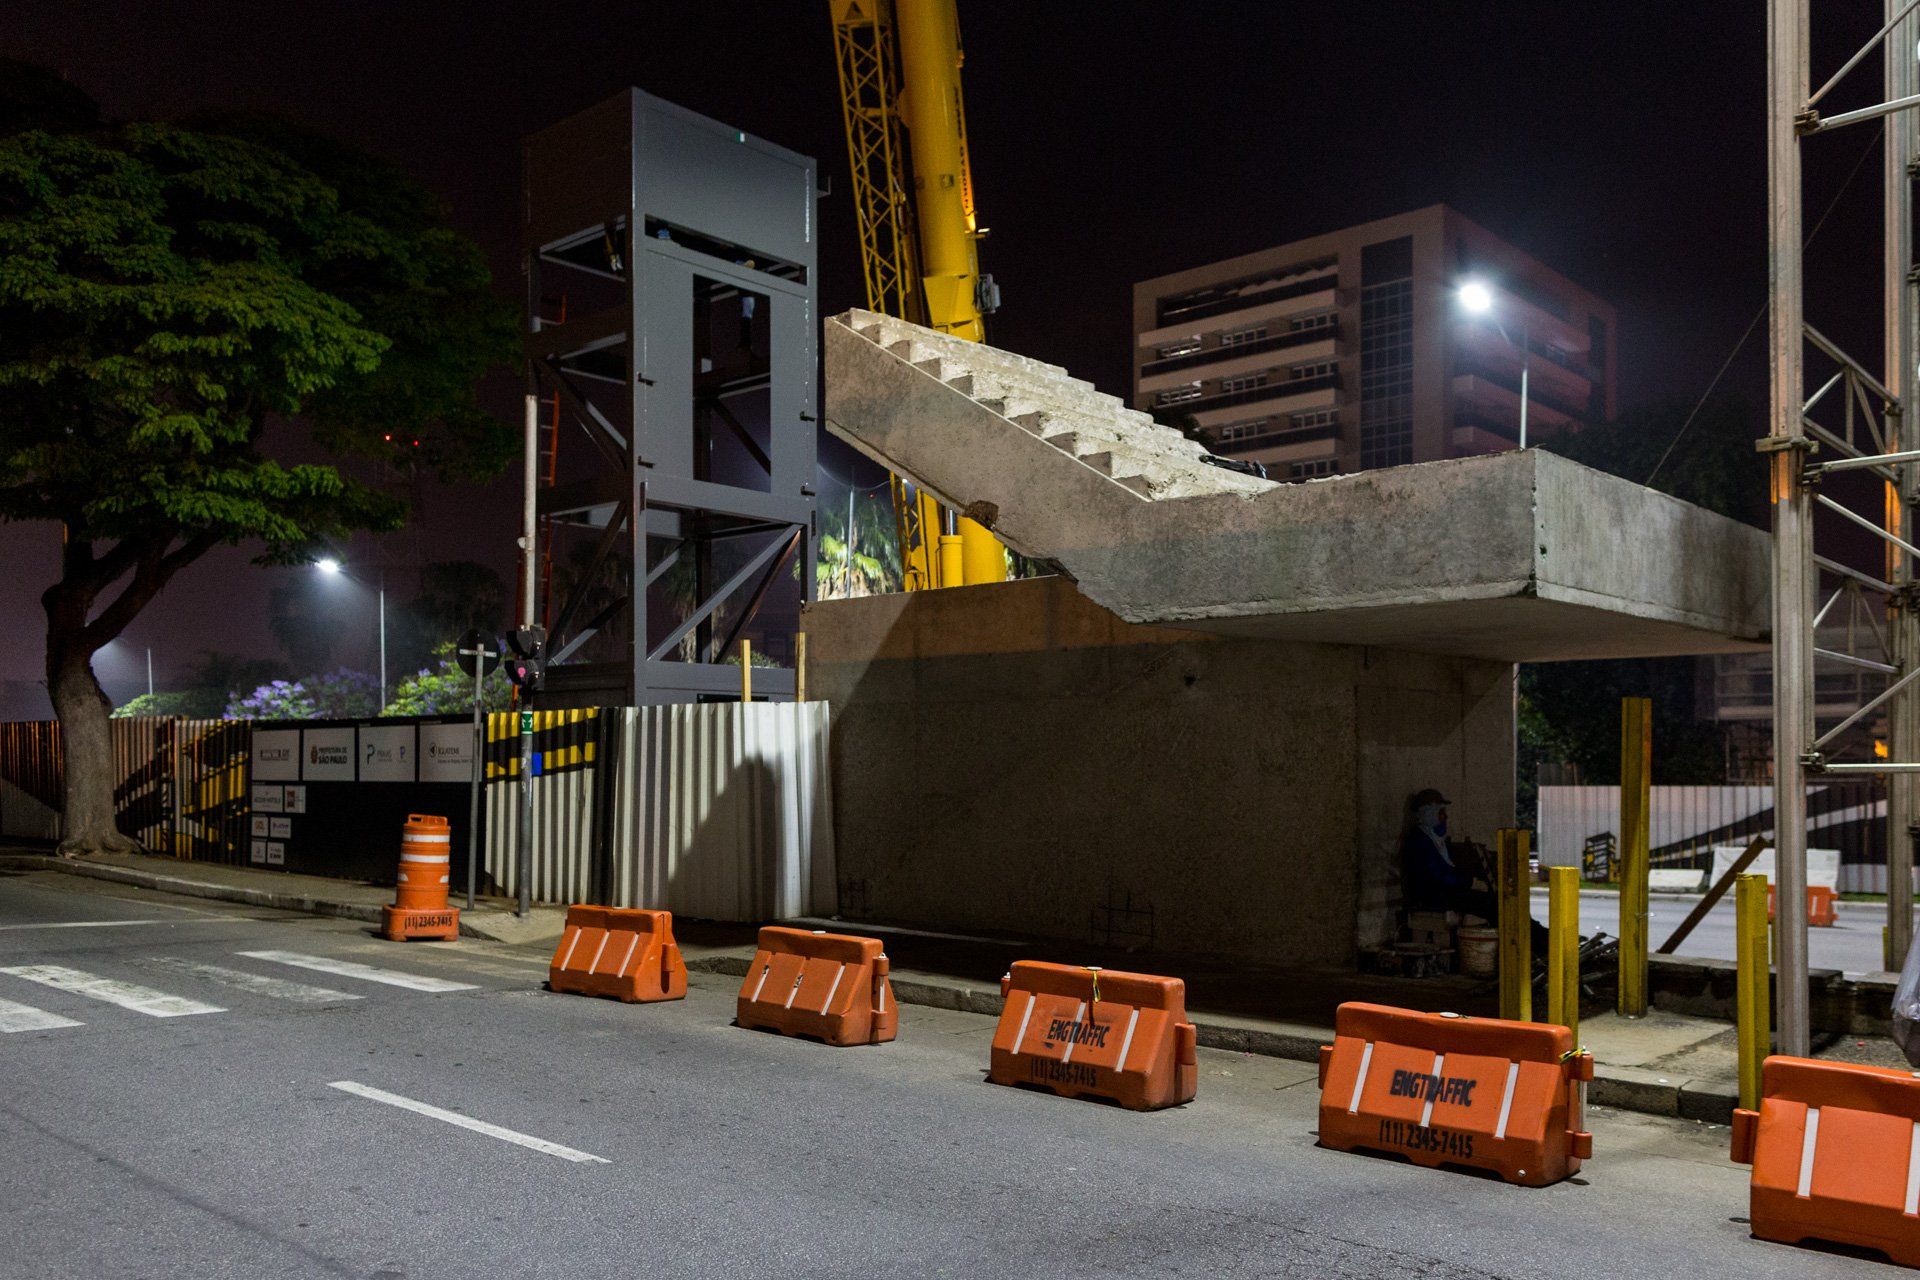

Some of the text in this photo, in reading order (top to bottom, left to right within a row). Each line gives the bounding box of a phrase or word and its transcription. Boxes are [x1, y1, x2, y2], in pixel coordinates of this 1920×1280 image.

[318, 754, 348, 765] SÃO PAULO
[404, 914, 453, 929] (11) 2345-7415
[1047, 1018, 1110, 1048] ENGTRAFFIC
[1049, 1061, 1097, 1088] 2345-7415
[1390, 1069, 1477, 1107] ENGTRAFFIC
[1406, 1124, 1473, 1158] 2345-7415
